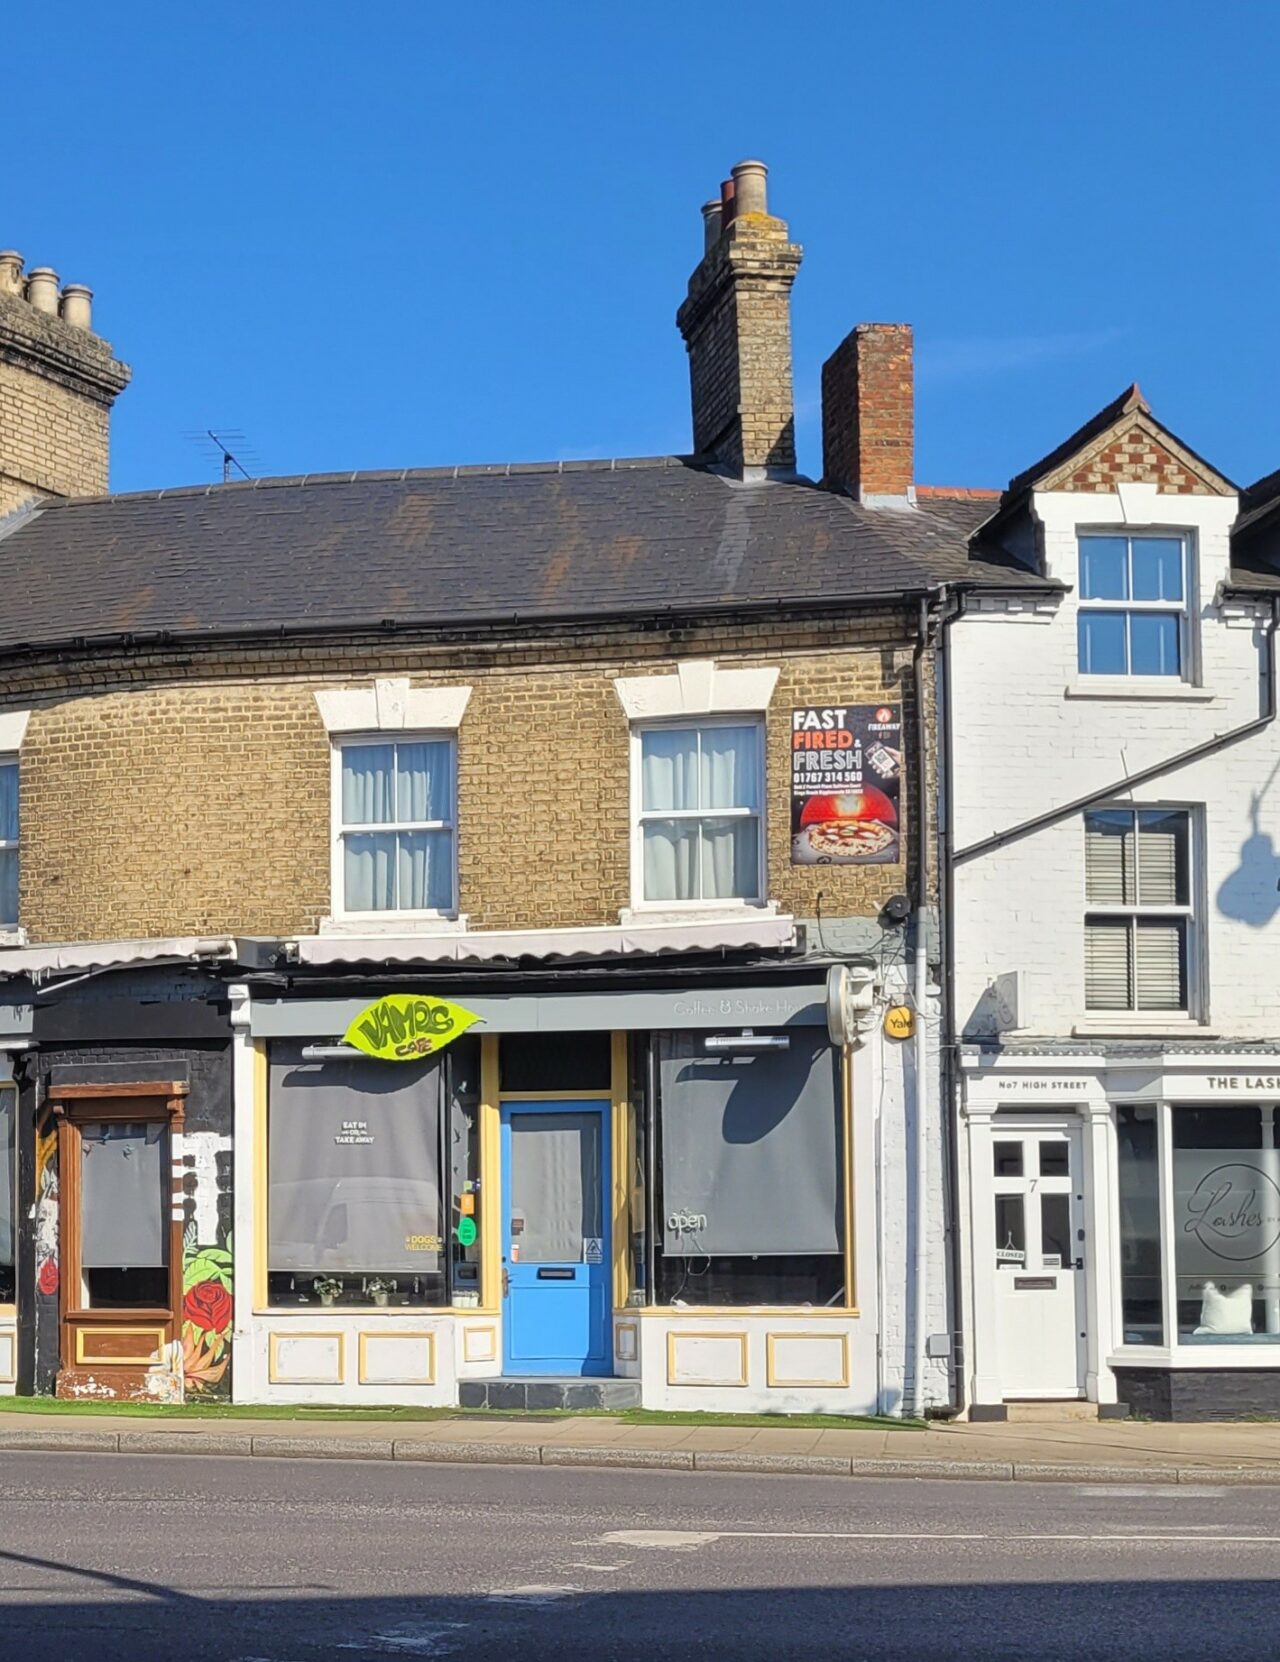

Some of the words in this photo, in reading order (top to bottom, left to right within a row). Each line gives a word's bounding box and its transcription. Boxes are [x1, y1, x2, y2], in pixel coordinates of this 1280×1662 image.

[793, 709, 847, 731] FAST
[793, 730, 854, 749] FIRED
[853, 739, 862, 748] &
[793, 749, 862, 771] FRESH
[793, 772, 823, 783] 01767
[824, 771, 843, 783] 314
[357, 1000, 455, 1050] VAMOS
[890, 1018, 913, 1029] Yale
[394, 1037, 433, 1057] CAFE
[1022, 1081, 1048, 1089] HIGH
[1051, 1081, 1088, 1089] STREET
[1207, 1077, 1239, 1089] THE
[342, 1121, 358, 1129] EAT
[358, 1121, 367, 1129] IN
[335, 1136, 355, 1144] TAKE
[355, 1136, 375, 1144] AWAY
[1029, 1179, 1038, 1193] 7
[1184, 1182, 1262, 1238] Lashes
[669, 1214, 708, 1236] open
[410, 1235, 437, 1244] DOGS
[405, 1243, 444, 1252] WELCOME
[996, 1250, 1024, 1259] CLOSED
